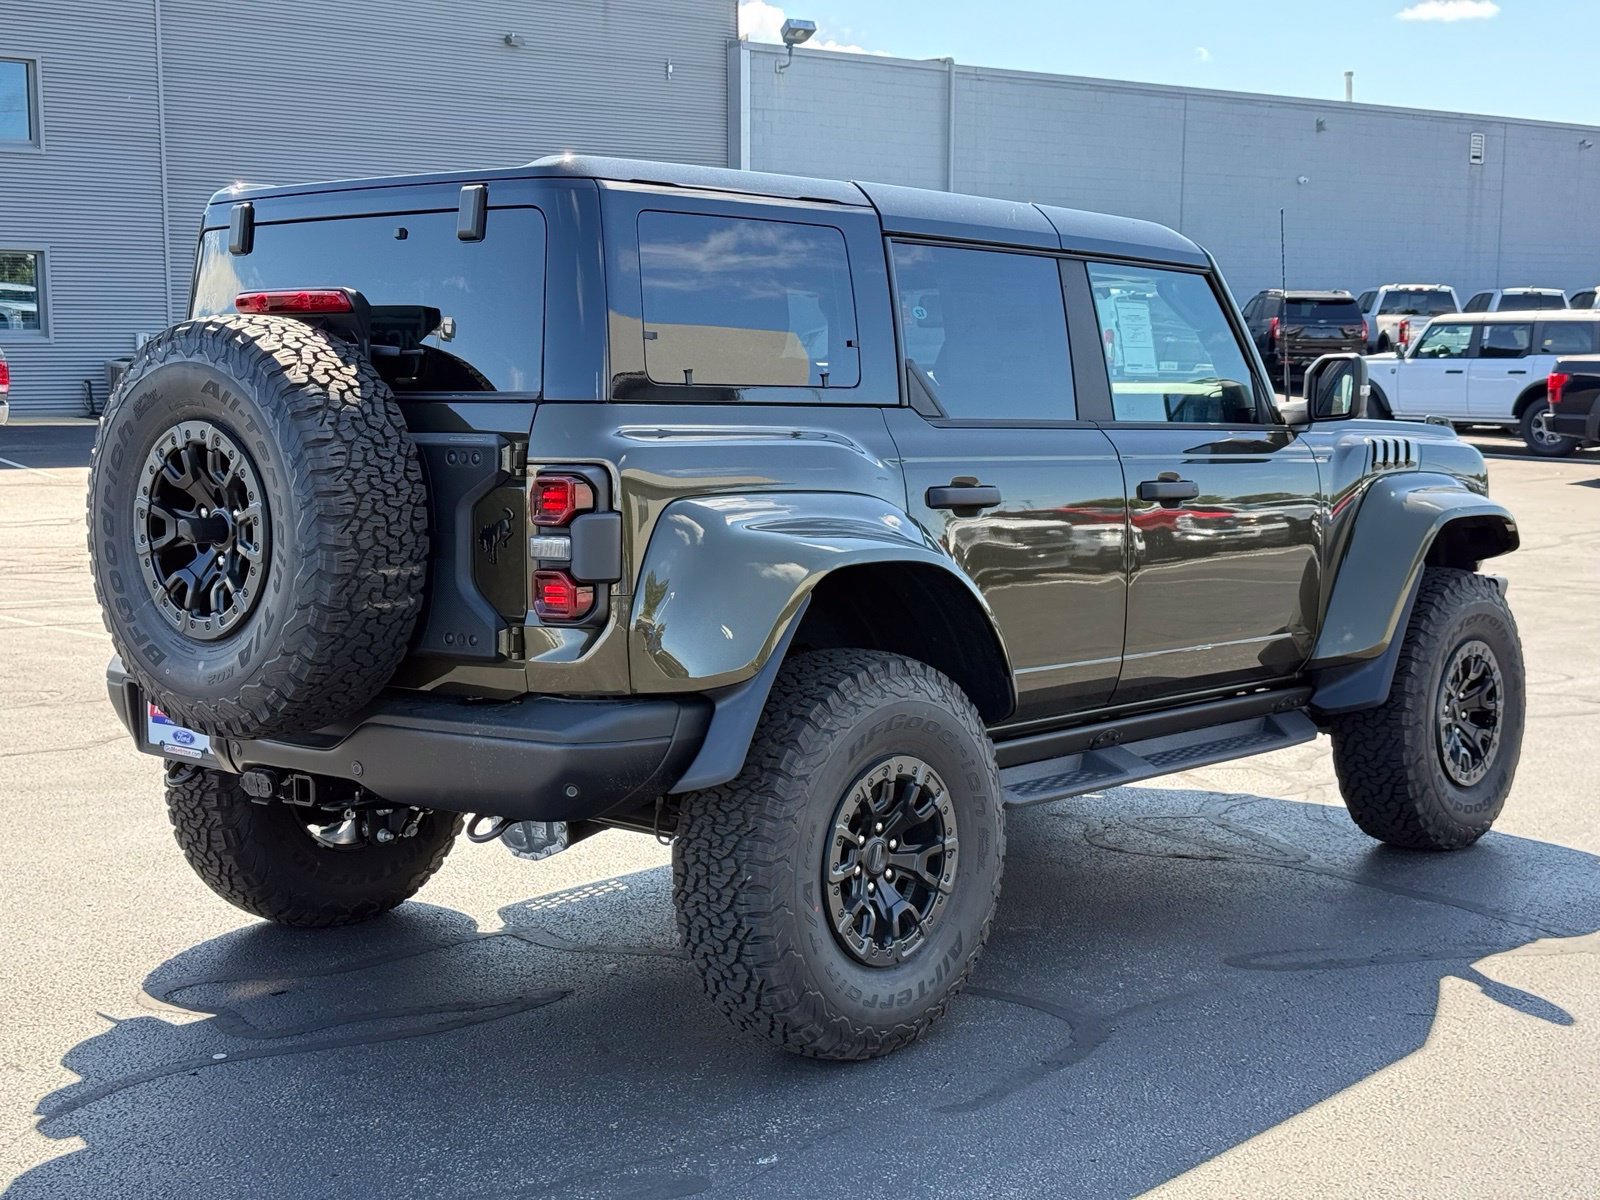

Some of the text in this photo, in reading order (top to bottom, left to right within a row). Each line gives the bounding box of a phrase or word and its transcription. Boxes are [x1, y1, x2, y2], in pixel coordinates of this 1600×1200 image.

[200, 379, 288, 593] All-Terrain
[95, 417, 168, 670] BFGoodrich
[239, 608, 280, 667] T/A
[176, 731, 193, 743] Ford
[847, 711, 988, 817] BFGoodrich
[824, 930, 964, 1010] All-Terrain
